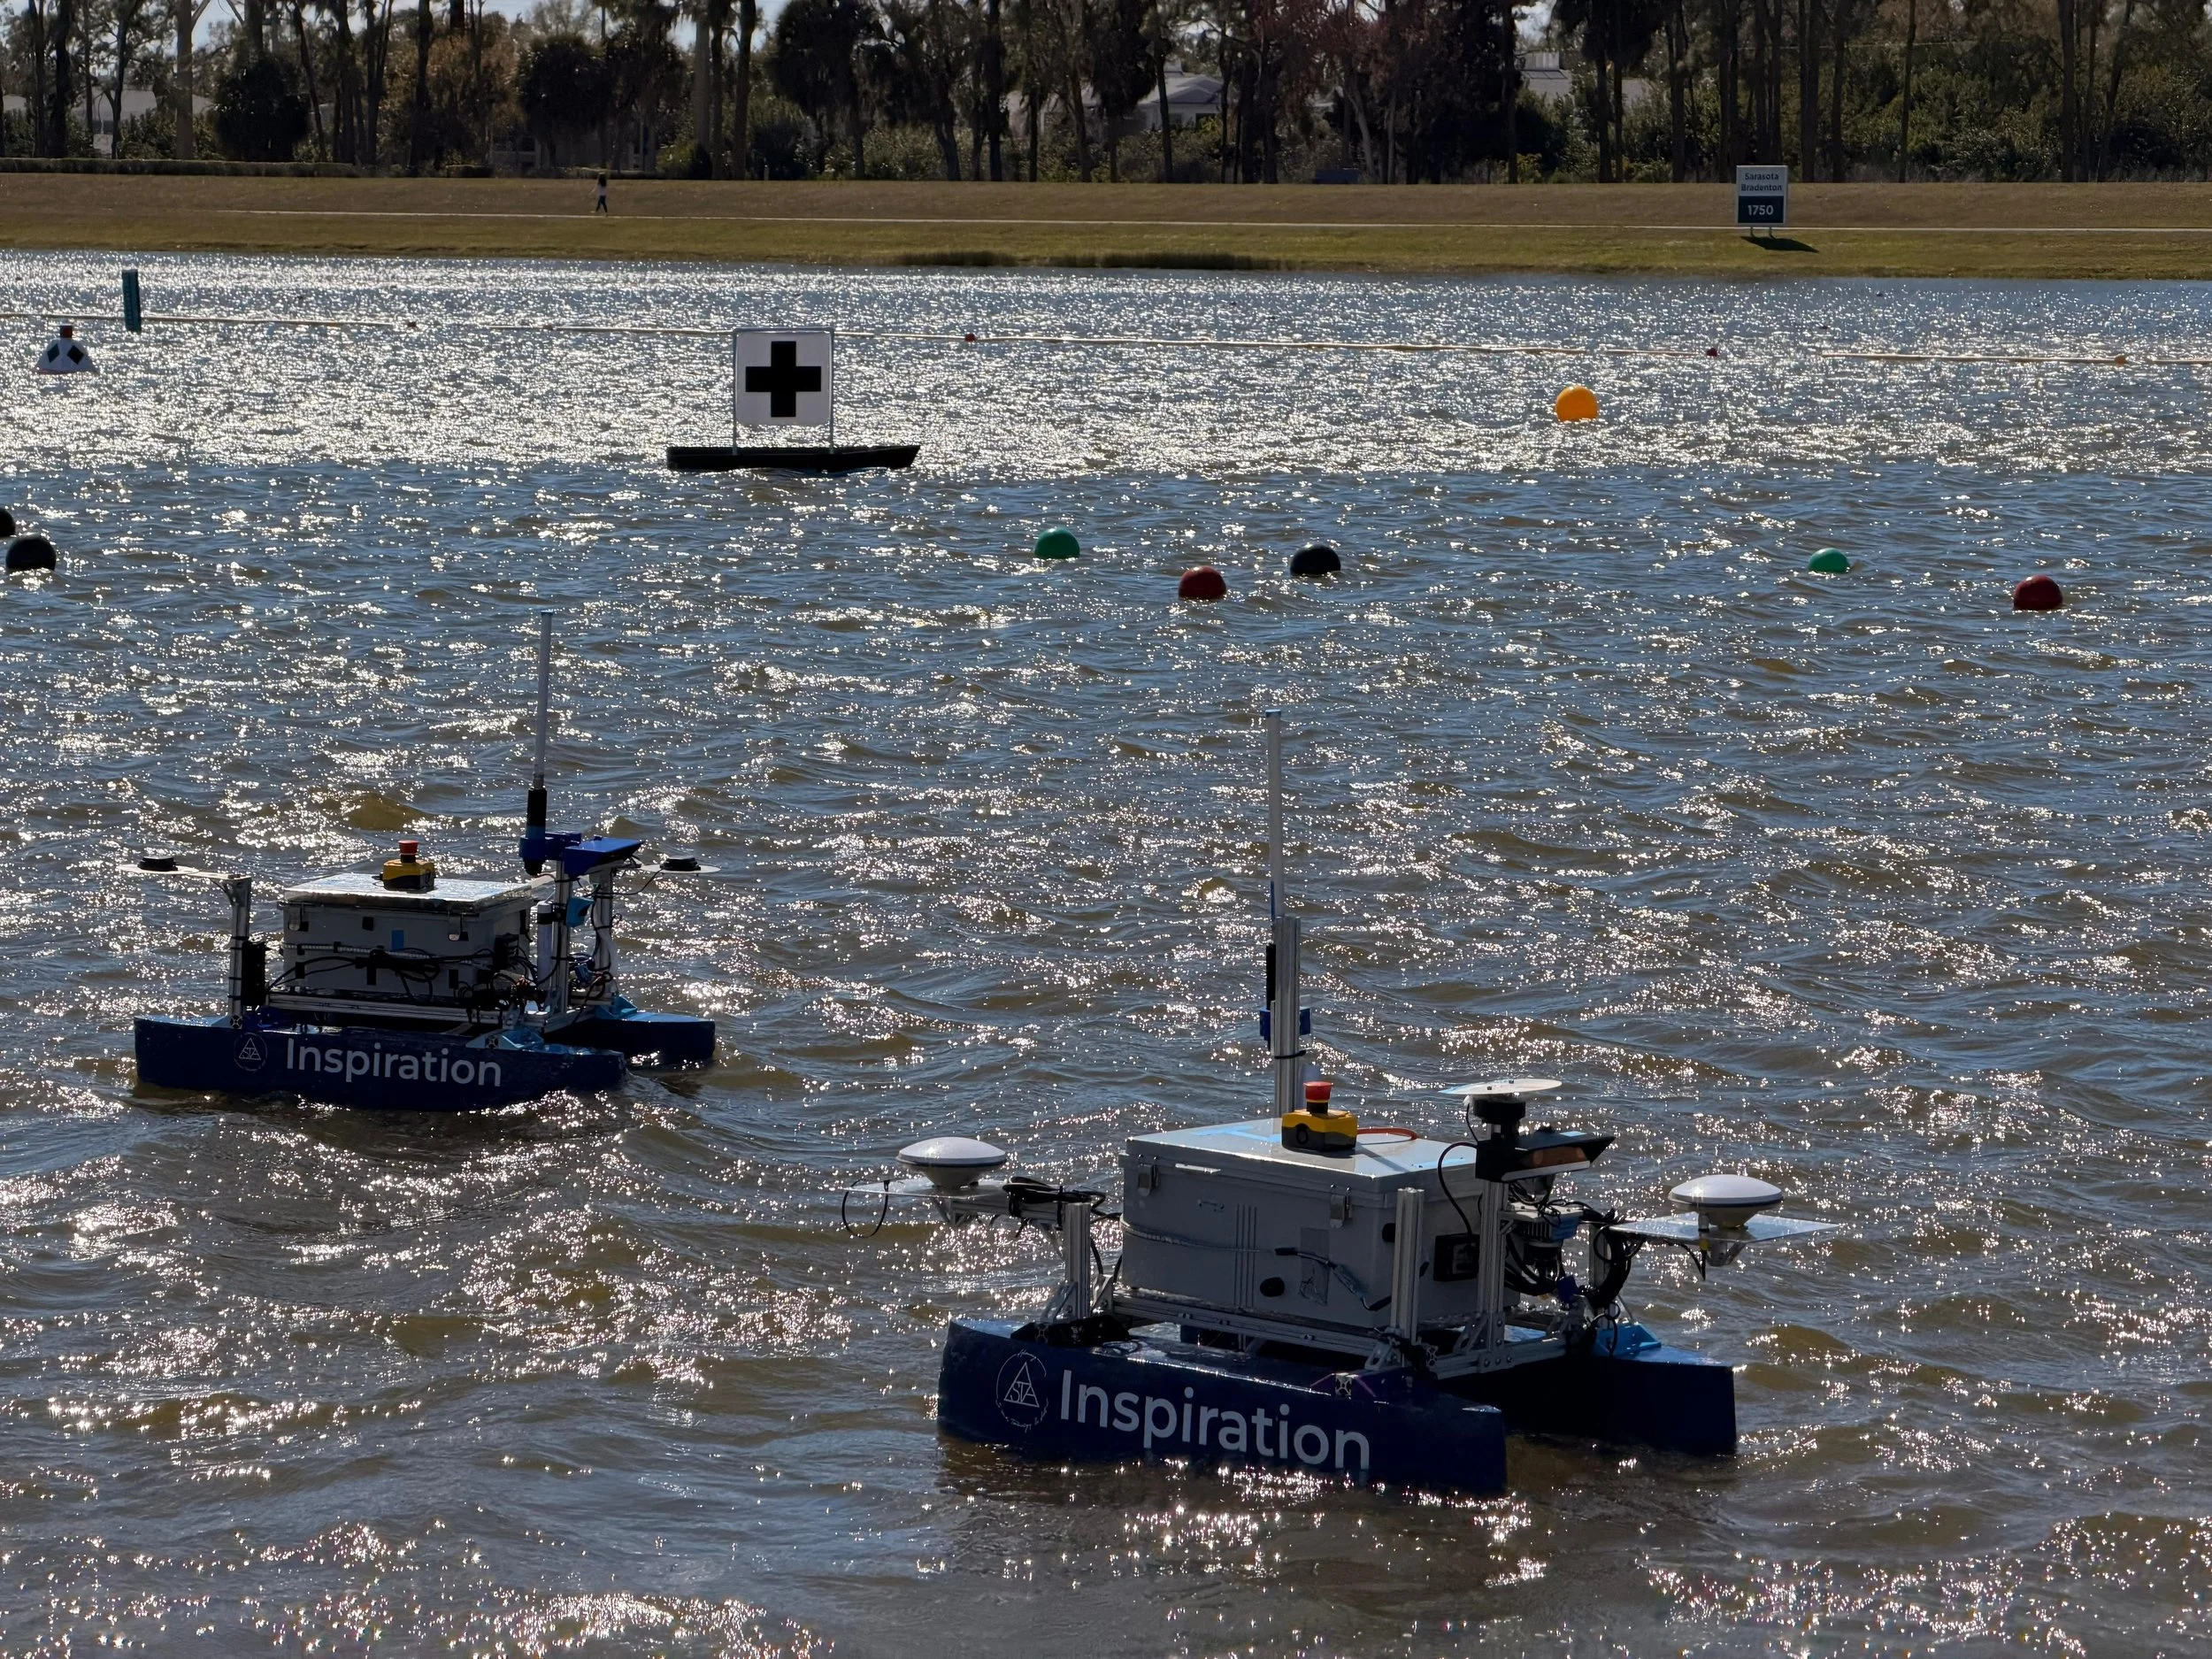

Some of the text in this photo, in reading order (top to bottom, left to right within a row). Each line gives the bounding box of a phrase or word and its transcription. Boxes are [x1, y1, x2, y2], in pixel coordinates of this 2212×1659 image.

[1747, 204, 1774, 216] 1750
[287, 1038, 501, 1087] Inspiration
[1061, 1369, 1371, 1470] Inspiration
